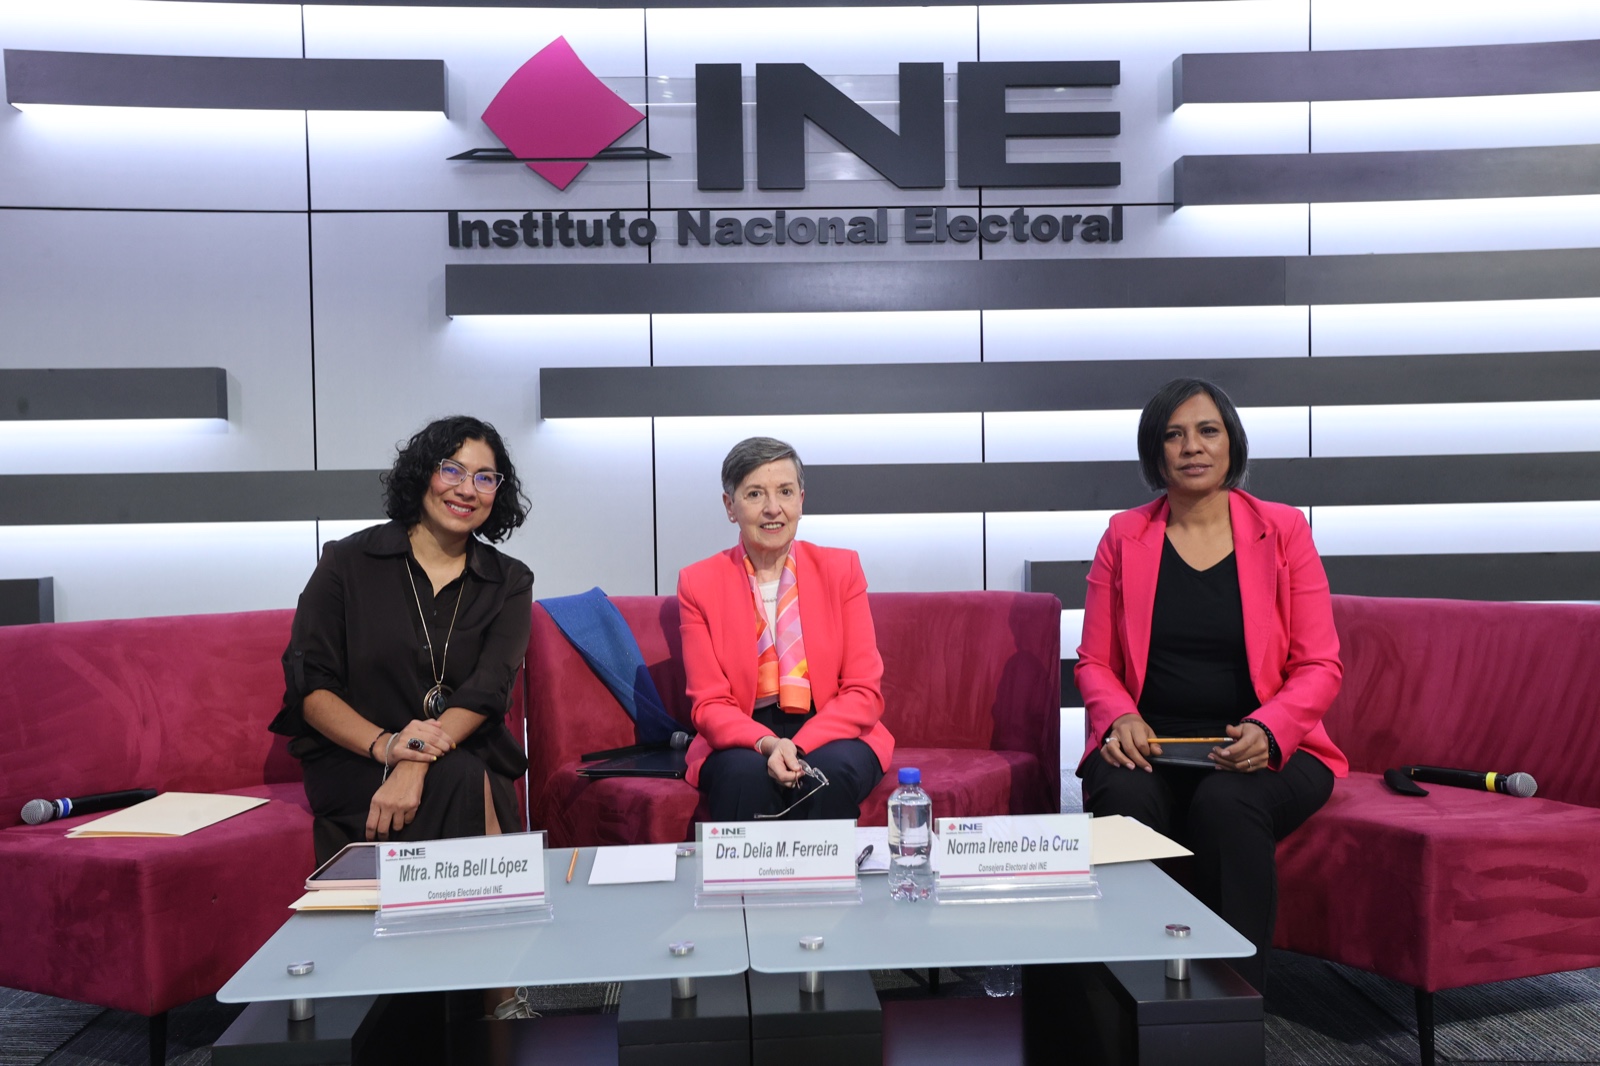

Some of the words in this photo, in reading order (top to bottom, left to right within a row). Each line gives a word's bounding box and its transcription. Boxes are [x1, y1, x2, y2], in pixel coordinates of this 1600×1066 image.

[695, 60, 1121, 190] INE
[448, 210, 656, 248] Instituto
[677, 208, 888, 246] Nacional
[904, 206, 1123, 243] Electoral
[722, 827, 746, 835] INE
[400, 848, 426, 856] INE
[716, 843, 739, 859] Dra.
[743, 842, 772, 858] Delia
[776, 841, 789, 857] M.
[792, 840, 838, 856] Ferreira
[947, 838, 986, 855] Norma
[989, 838, 1018, 853] Irene
[1021, 836, 1035, 852] De
[1039, 836, 1048, 851] la
[1052, 835, 1079, 851] Cruz
[399, 865, 431, 882] Mtra.
[434, 862, 459, 879] Rita
[463, 859, 486, 877] Bell
[490, 857, 528, 878] López
[759, 867, 795, 876] Conferencista
[978, 863, 1004, 874] Consejera
[1006, 863, 1028, 871] Electoral
[1029, 862, 1037, 870] del
[1038, 862, 1047, 870] INE
[428, 889, 456, 900] Consejera
[457, 887, 482, 896] Electoral
[483, 886, 491, 894] del
[492, 885, 502, 893] INE
